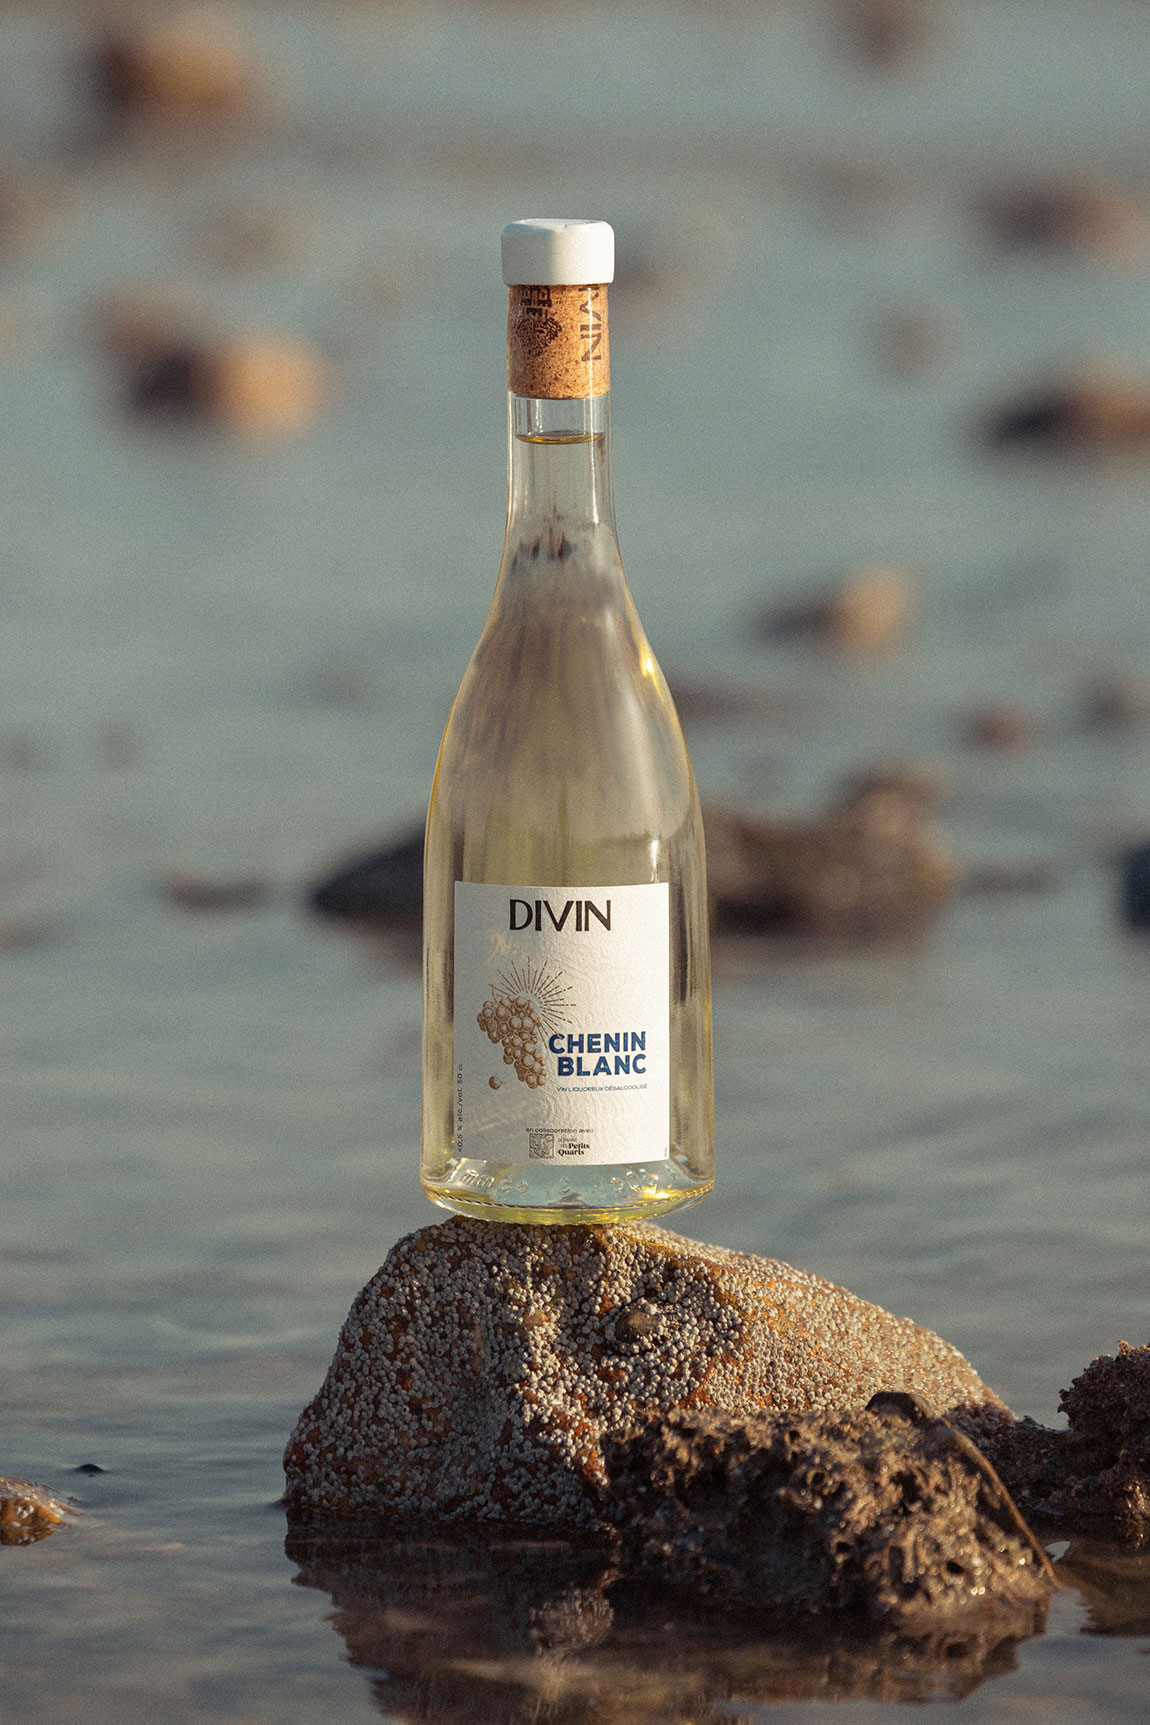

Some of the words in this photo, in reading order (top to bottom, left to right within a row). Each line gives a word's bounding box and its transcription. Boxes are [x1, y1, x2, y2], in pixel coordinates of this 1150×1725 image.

[578, 283, 602, 361] IVIN
[509, 899, 611, 931] DIVIN
[549, 1031, 646, 1053] CHENIN
[558, 1054, 646, 1076] BLANC
[457, 1073, 464, 1085] 50
[558, 1147, 585, 1156] Quarts
